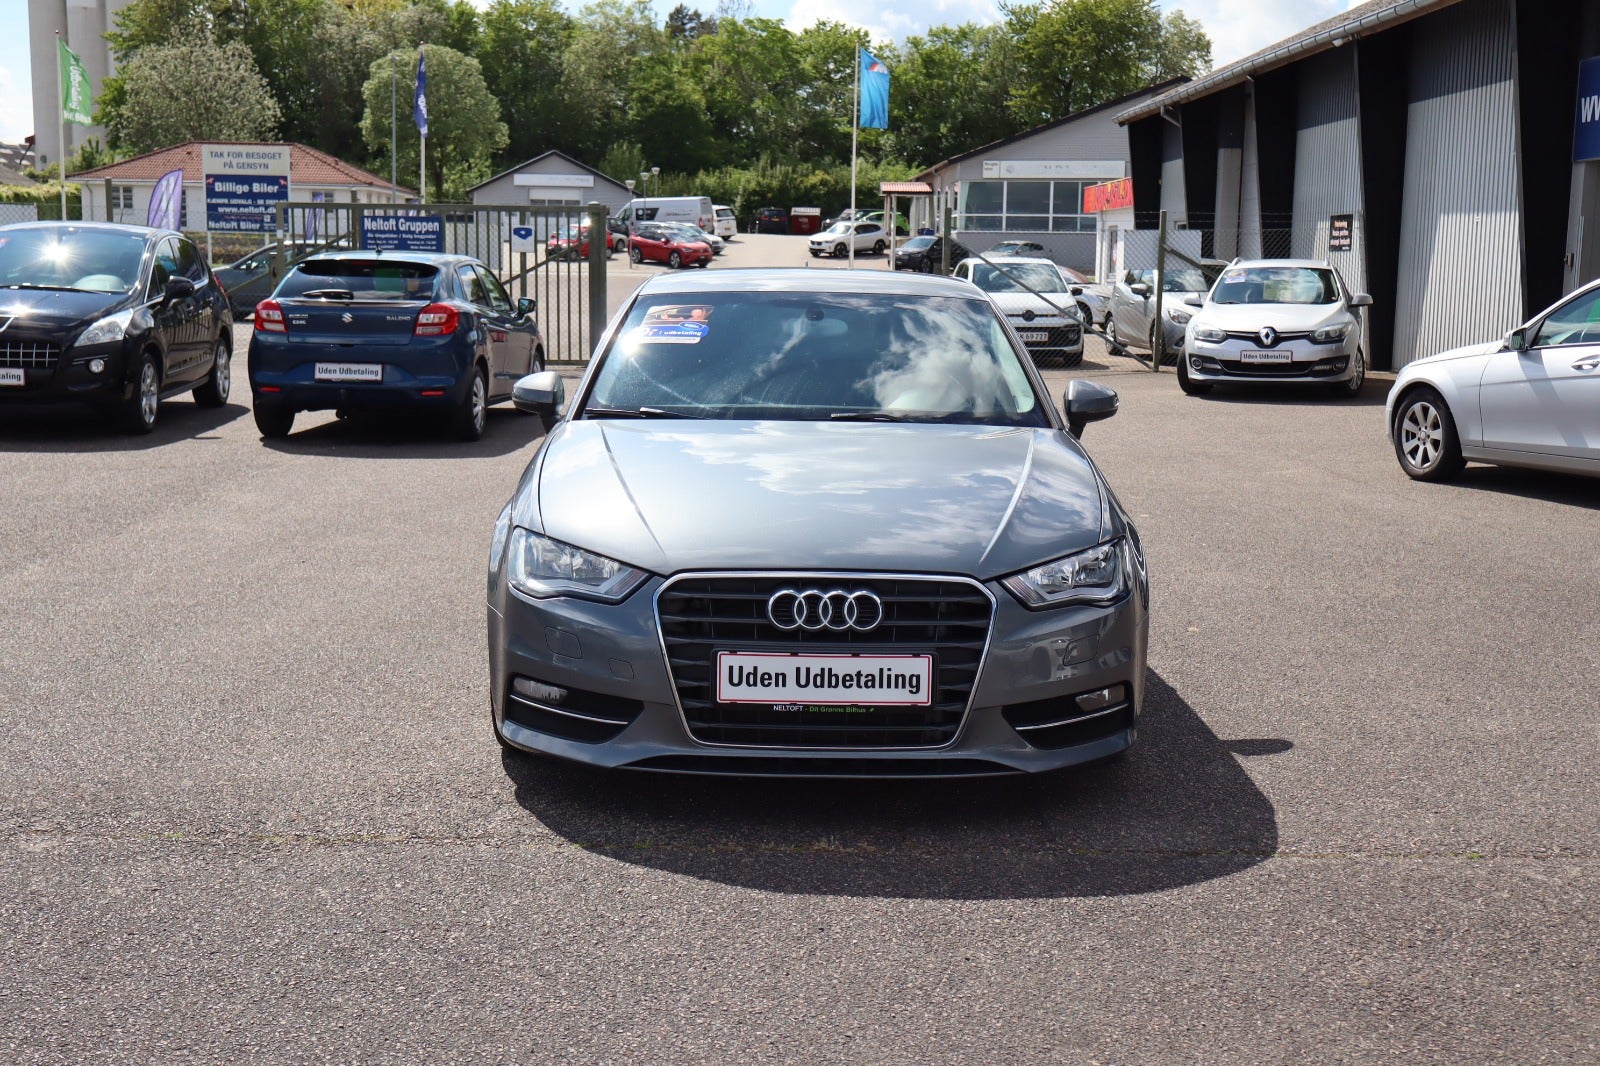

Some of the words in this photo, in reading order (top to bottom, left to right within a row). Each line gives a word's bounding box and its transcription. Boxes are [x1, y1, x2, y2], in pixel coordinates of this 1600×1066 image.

[210, 151, 224, 159] TAK
[245, 152, 282, 160] BESØGET
[223, 160, 234, 169] PÅ
[236, 162, 269, 170] GENSYN
[214, 182, 249, 194] Billige
[252, 182, 279, 193] Biler
[208, 220, 238, 230] Neltoft
[240, 221, 260, 230] Biler
[364, 218, 396, 230] Neltoft
[398, 218, 440, 234] Gruppen
[318, 367, 337, 375] Uden
[339, 367, 379, 377] Udbetaling
[728, 665, 787, 688] Uden
[795, 666, 921, 695] Udbetaling
